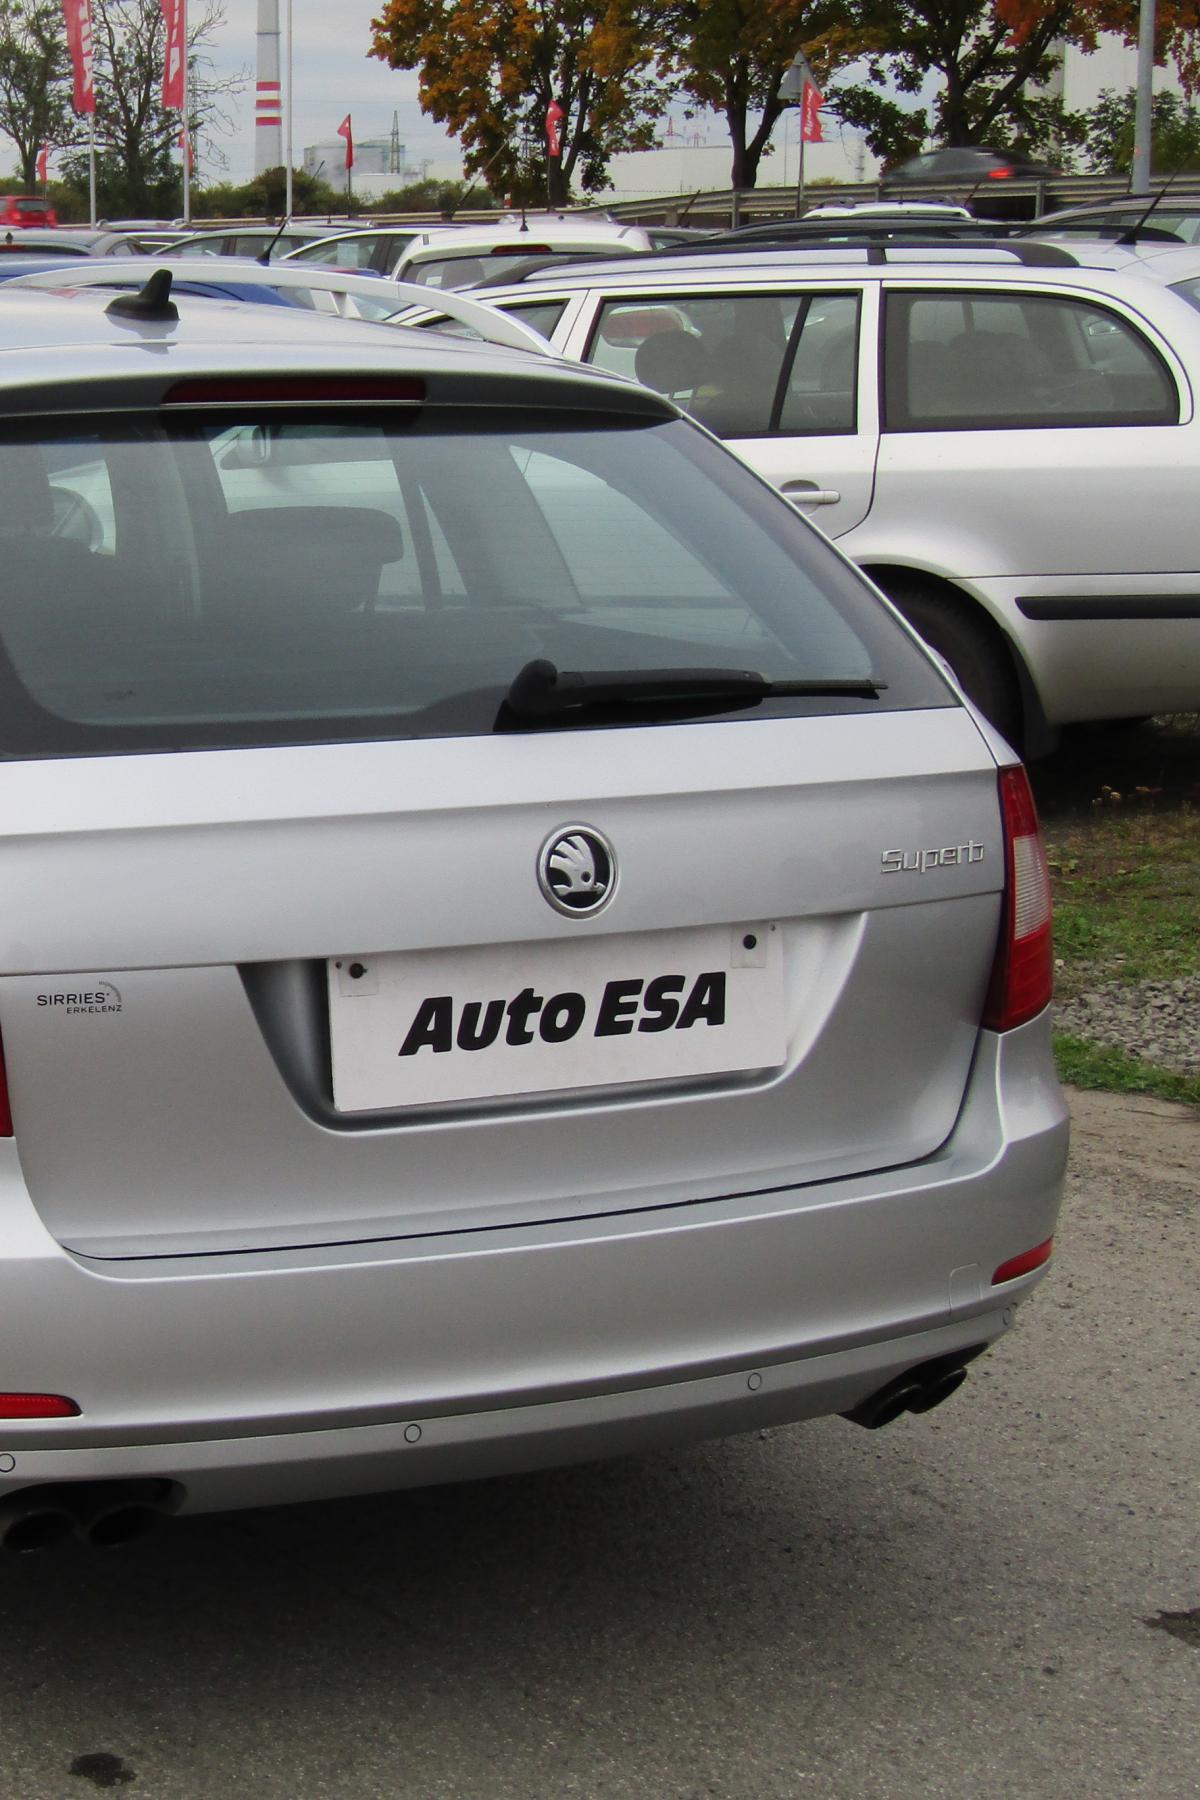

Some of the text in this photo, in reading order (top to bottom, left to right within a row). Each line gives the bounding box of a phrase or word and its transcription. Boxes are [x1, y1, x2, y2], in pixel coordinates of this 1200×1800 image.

[881, 840, 984, 873] Superb
[37, 992, 106, 1006] SIRRIES
[66, 1005, 122, 1014] ERKELENZ
[398, 971, 726, 1056] Auto ESA
